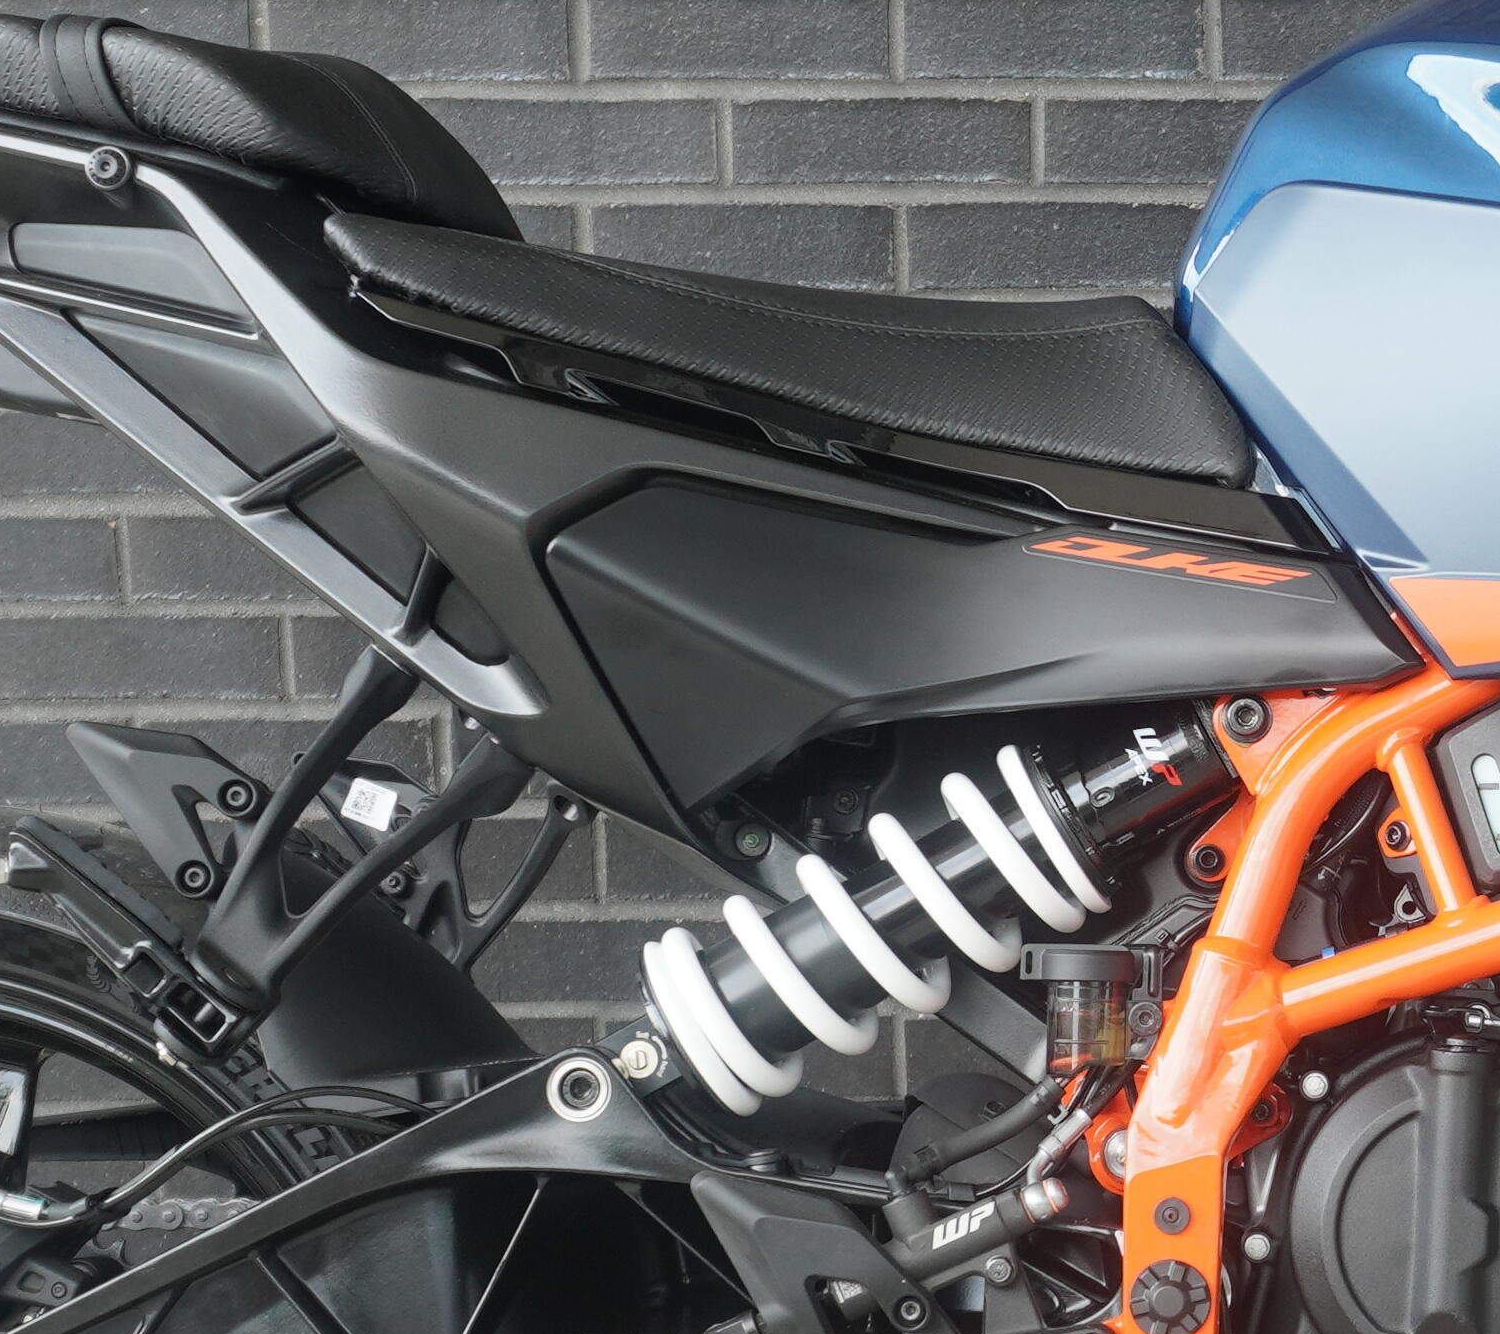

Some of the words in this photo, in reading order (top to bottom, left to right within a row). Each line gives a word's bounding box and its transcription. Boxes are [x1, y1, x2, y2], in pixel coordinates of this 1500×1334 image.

[1030, 536, 1313, 586] DUKE
[1132, 727, 1184, 787] WP
[931, 1200, 996, 1250] WP
